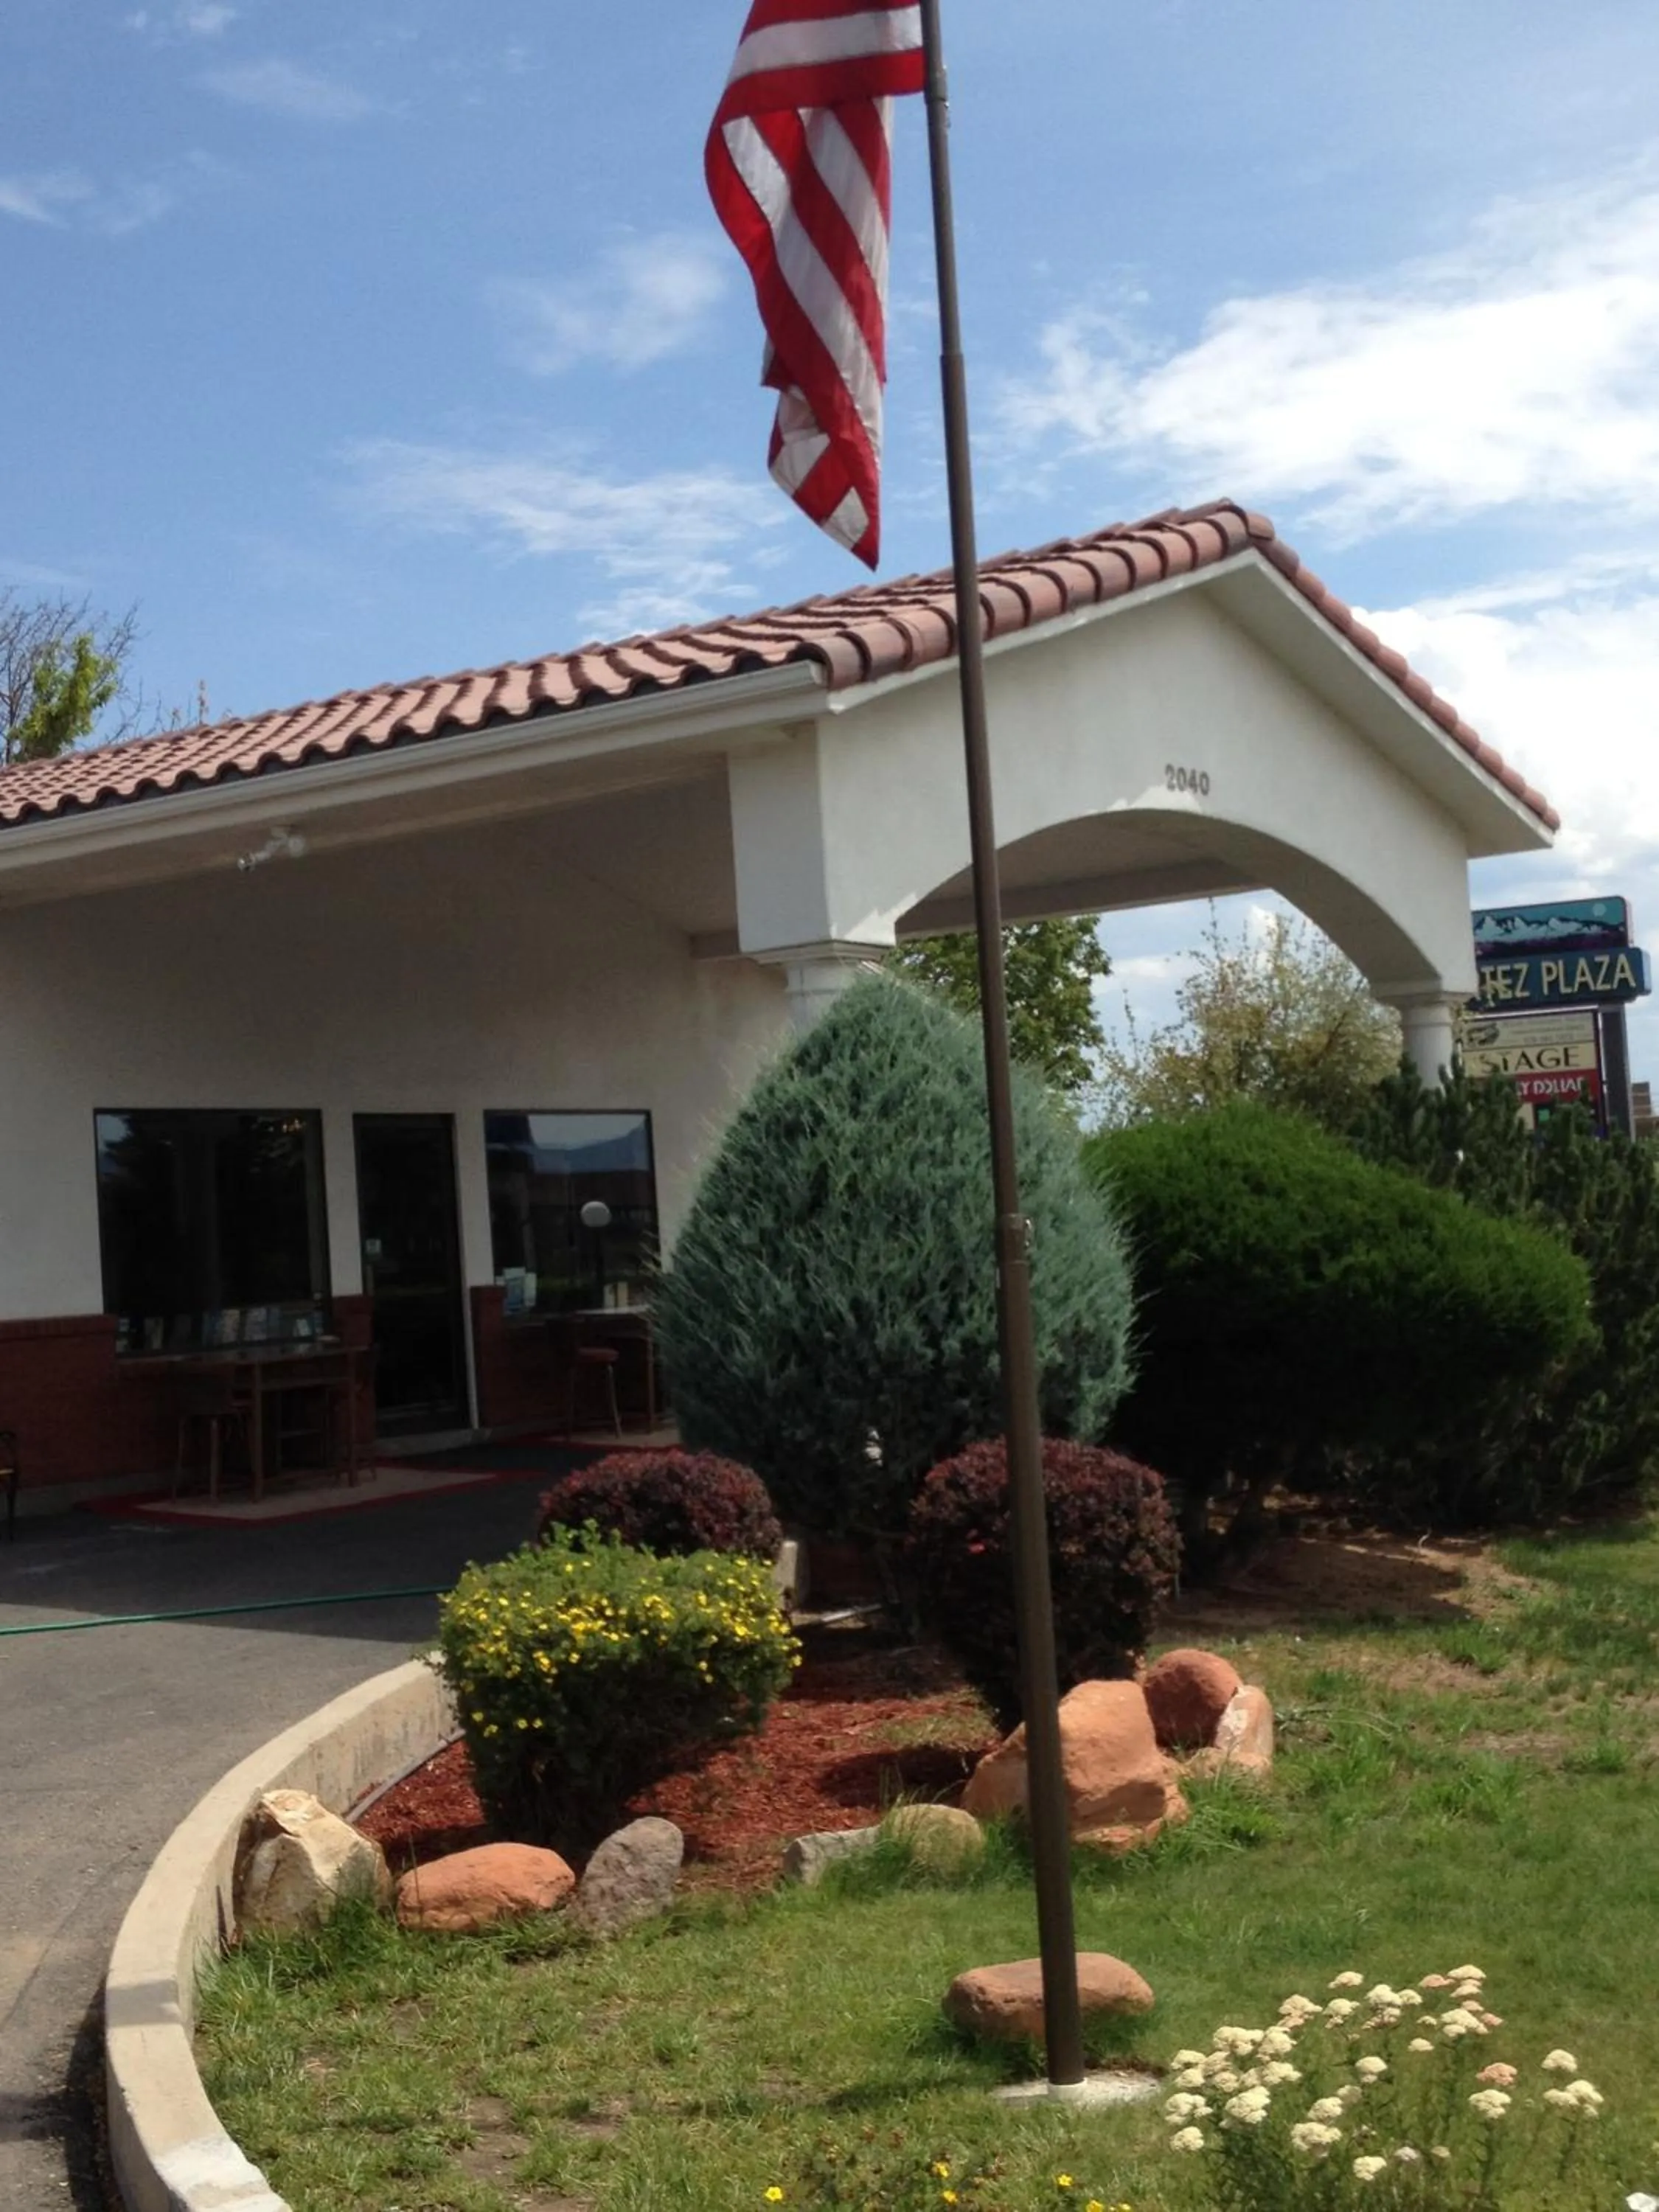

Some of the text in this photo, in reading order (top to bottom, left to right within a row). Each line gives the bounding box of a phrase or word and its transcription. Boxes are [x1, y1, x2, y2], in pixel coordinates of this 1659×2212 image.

[1165, 763, 1210, 796] 2040
[1541, 953, 1637, 995] PLAZA
[1479, 1046, 1581, 1074] STAGE
